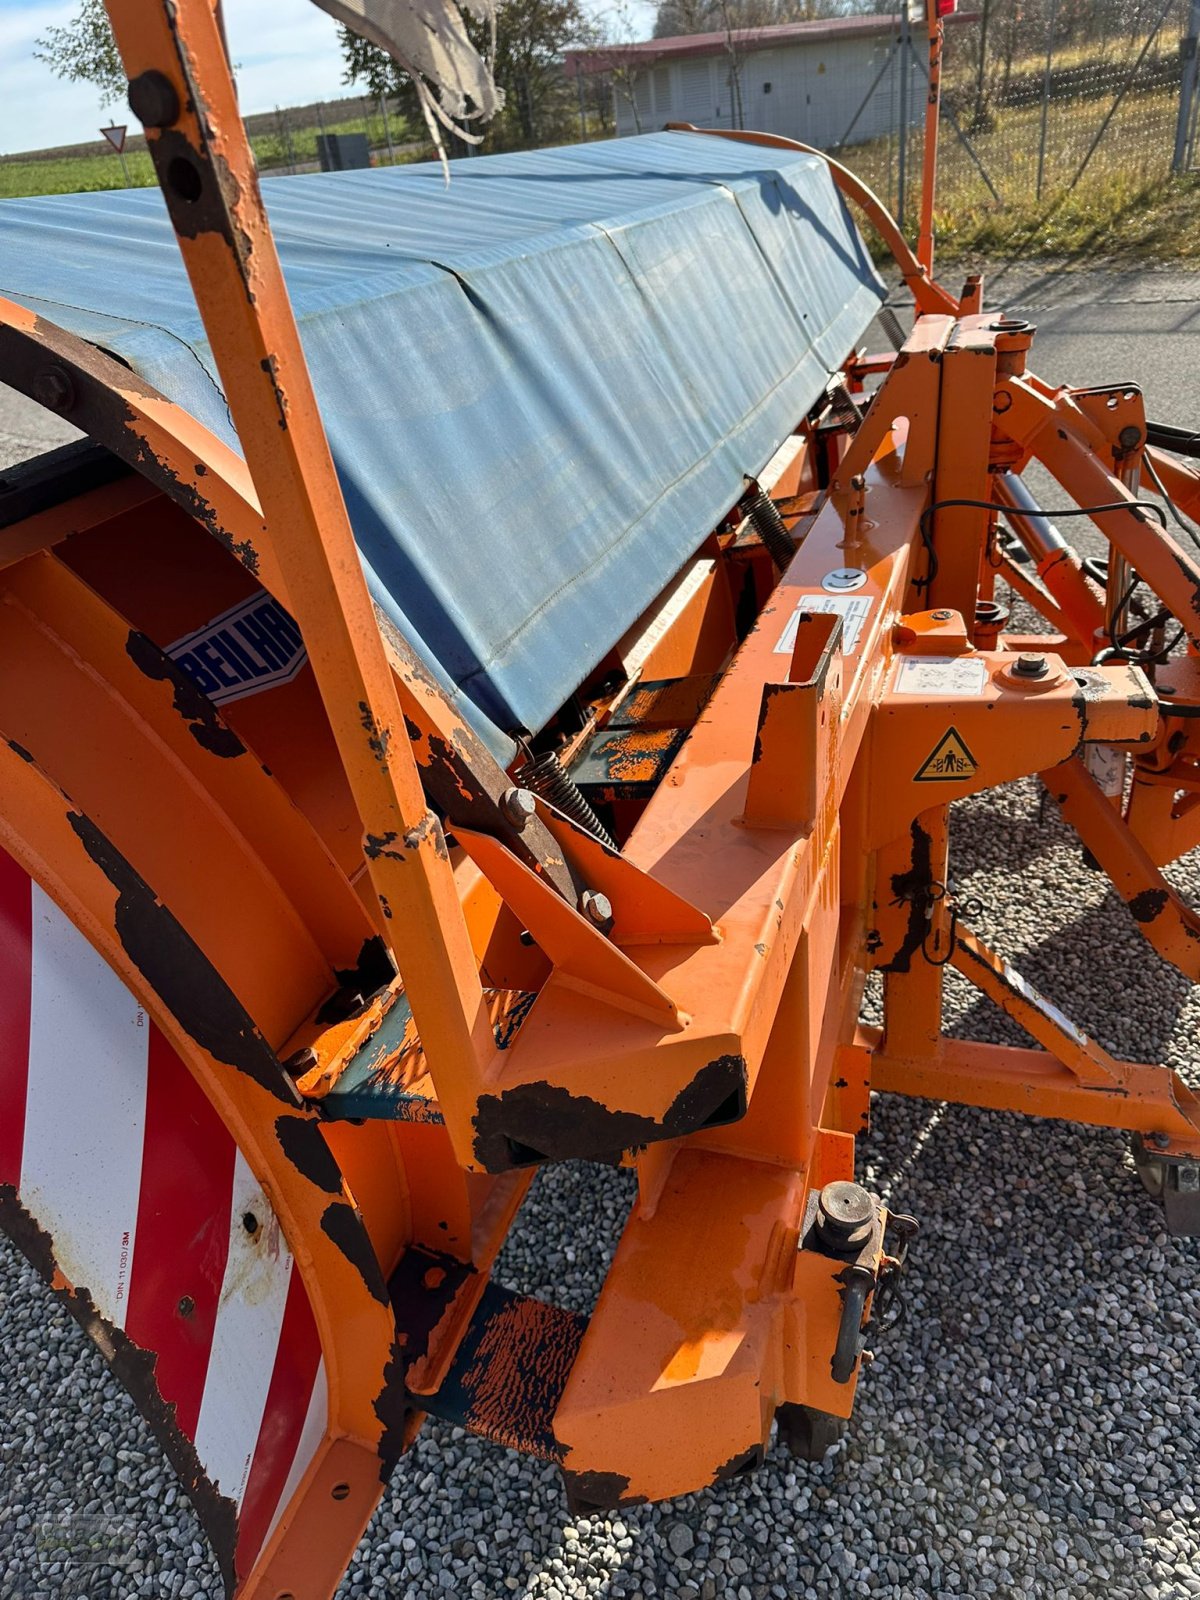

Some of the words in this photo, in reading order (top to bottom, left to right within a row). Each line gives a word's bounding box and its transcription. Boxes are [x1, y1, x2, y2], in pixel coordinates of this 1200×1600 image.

[174, 599, 303, 695] BEILHA
[136, 1011, 144, 1027] DIN
[119, 1270, 126, 1280] 11
[116, 1282, 125, 1300] DIN
